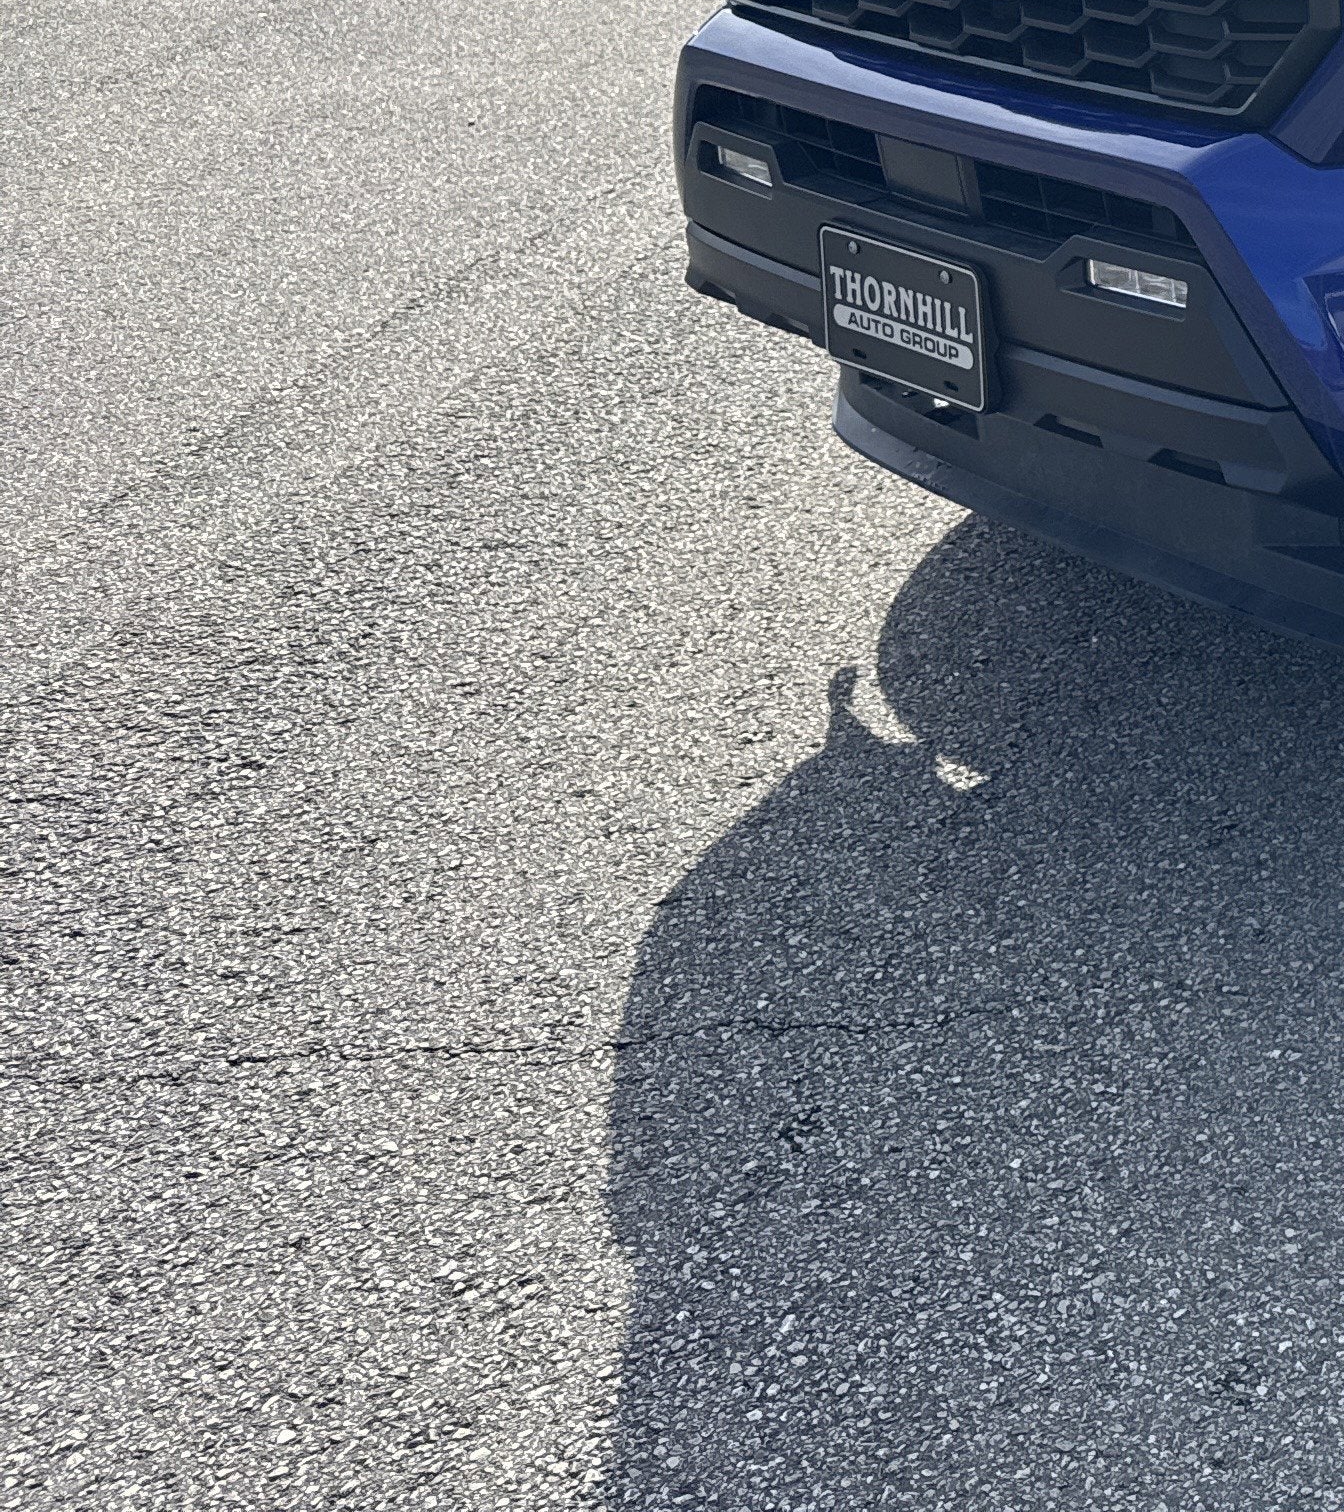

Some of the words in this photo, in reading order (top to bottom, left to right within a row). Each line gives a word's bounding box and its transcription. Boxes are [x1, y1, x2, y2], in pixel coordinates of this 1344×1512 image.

[830, 266, 973, 343] THORNHILL
[848, 312, 895, 339] AUTO
[900, 328, 959, 361] GROUP
